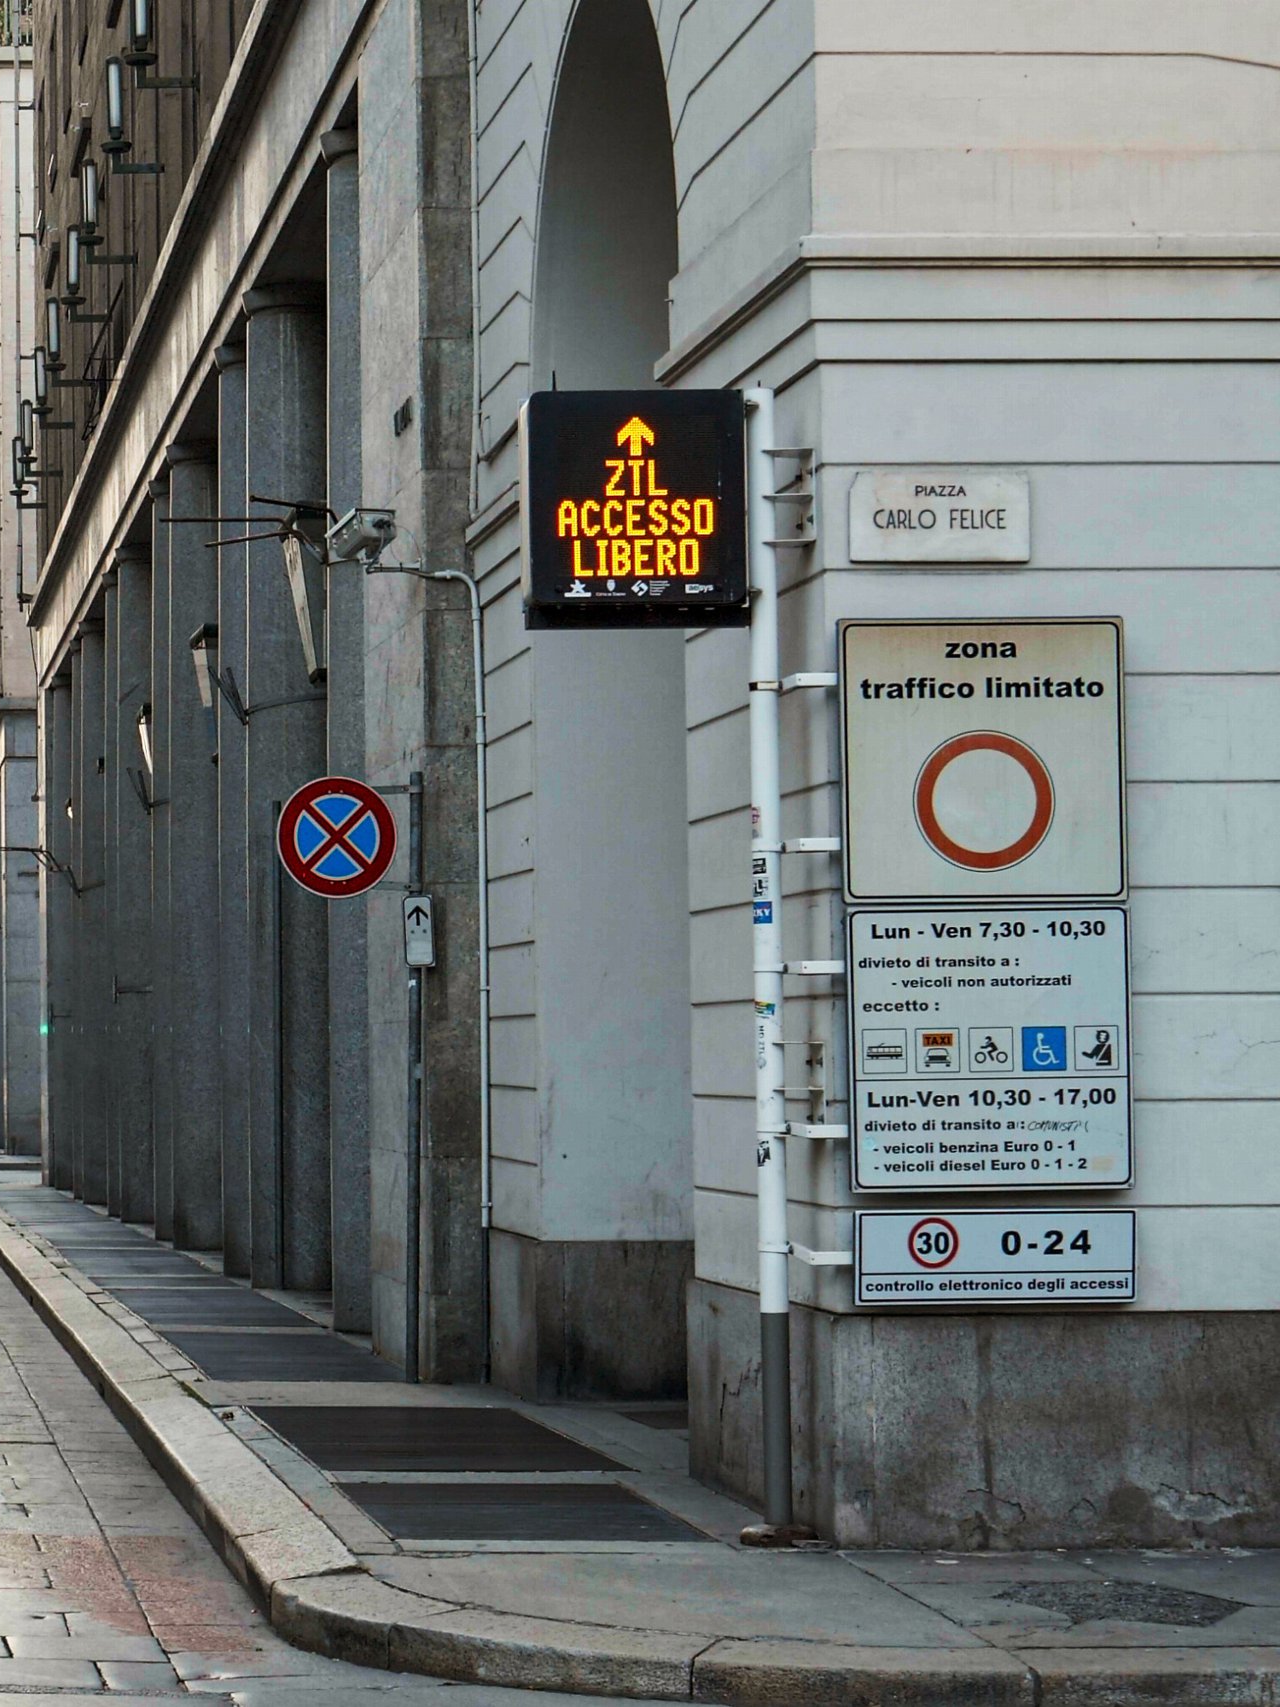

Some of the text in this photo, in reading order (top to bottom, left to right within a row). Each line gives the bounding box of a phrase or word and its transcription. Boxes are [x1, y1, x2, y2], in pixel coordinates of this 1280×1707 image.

[605, 460, 667, 497] ZTL
[915, 485, 966, 497] PIAZZA
[558, 499, 714, 537] ACCESSO
[874, 509, 1007, 530] CARLO FELICE
[573, 539, 699, 577] LIBERO
[945, 642, 1017, 658] zona
[861, 677, 1104, 699] traffico limitato
[871, 924, 910, 939] Lun
[931, 923, 972, 938] Ven
[979, 922, 1026, 940] 7,30
[1047, 921, 1106, 939] 10,30
[859, 957, 911, 968] divieto
[916, 957, 929, 968] di
[935, 956, 996, 967] transito
[1001, 958, 1010, 967] a
[902, 977, 952, 988] veicoli
[957, 978, 985, 987] non
[991, 975, 1071, 986] autorizzati
[863, 1000, 929, 1012] eccetto
[924, 1035, 951, 1046] TAXI
[868, 1091, 960, 1108] Lun-Ven
[969, 1090, 1031, 1109] 10,30
[1054, 1088, 1116, 1108] 17,00
[865, 1121, 917, 1132] divieto
[922, 1120, 936, 1131] di
[941, 1120, 1001, 1131] transito
[884, 1142, 934, 1154] veicoli
[939, 1141, 998, 1153] benzina
[1004, 1141, 1039, 1152] Euro
[1044, 1141, 1053, 1151] 0
[1068, 1140, 1075, 1151] 1
[884, 1161, 934, 1173] veicoli
[939, 1160, 985, 1172] diesel
[991, 1160, 1025, 1171] Euro
[1031, 1159, 1040, 1170] 0
[1055, 1159, 1062, 1169] 1
[1078, 1158, 1087, 1169] 2
[917, 1232, 950, 1255] 30
[866, 1278, 1128, 1292] controllo elettronico degli accessi
